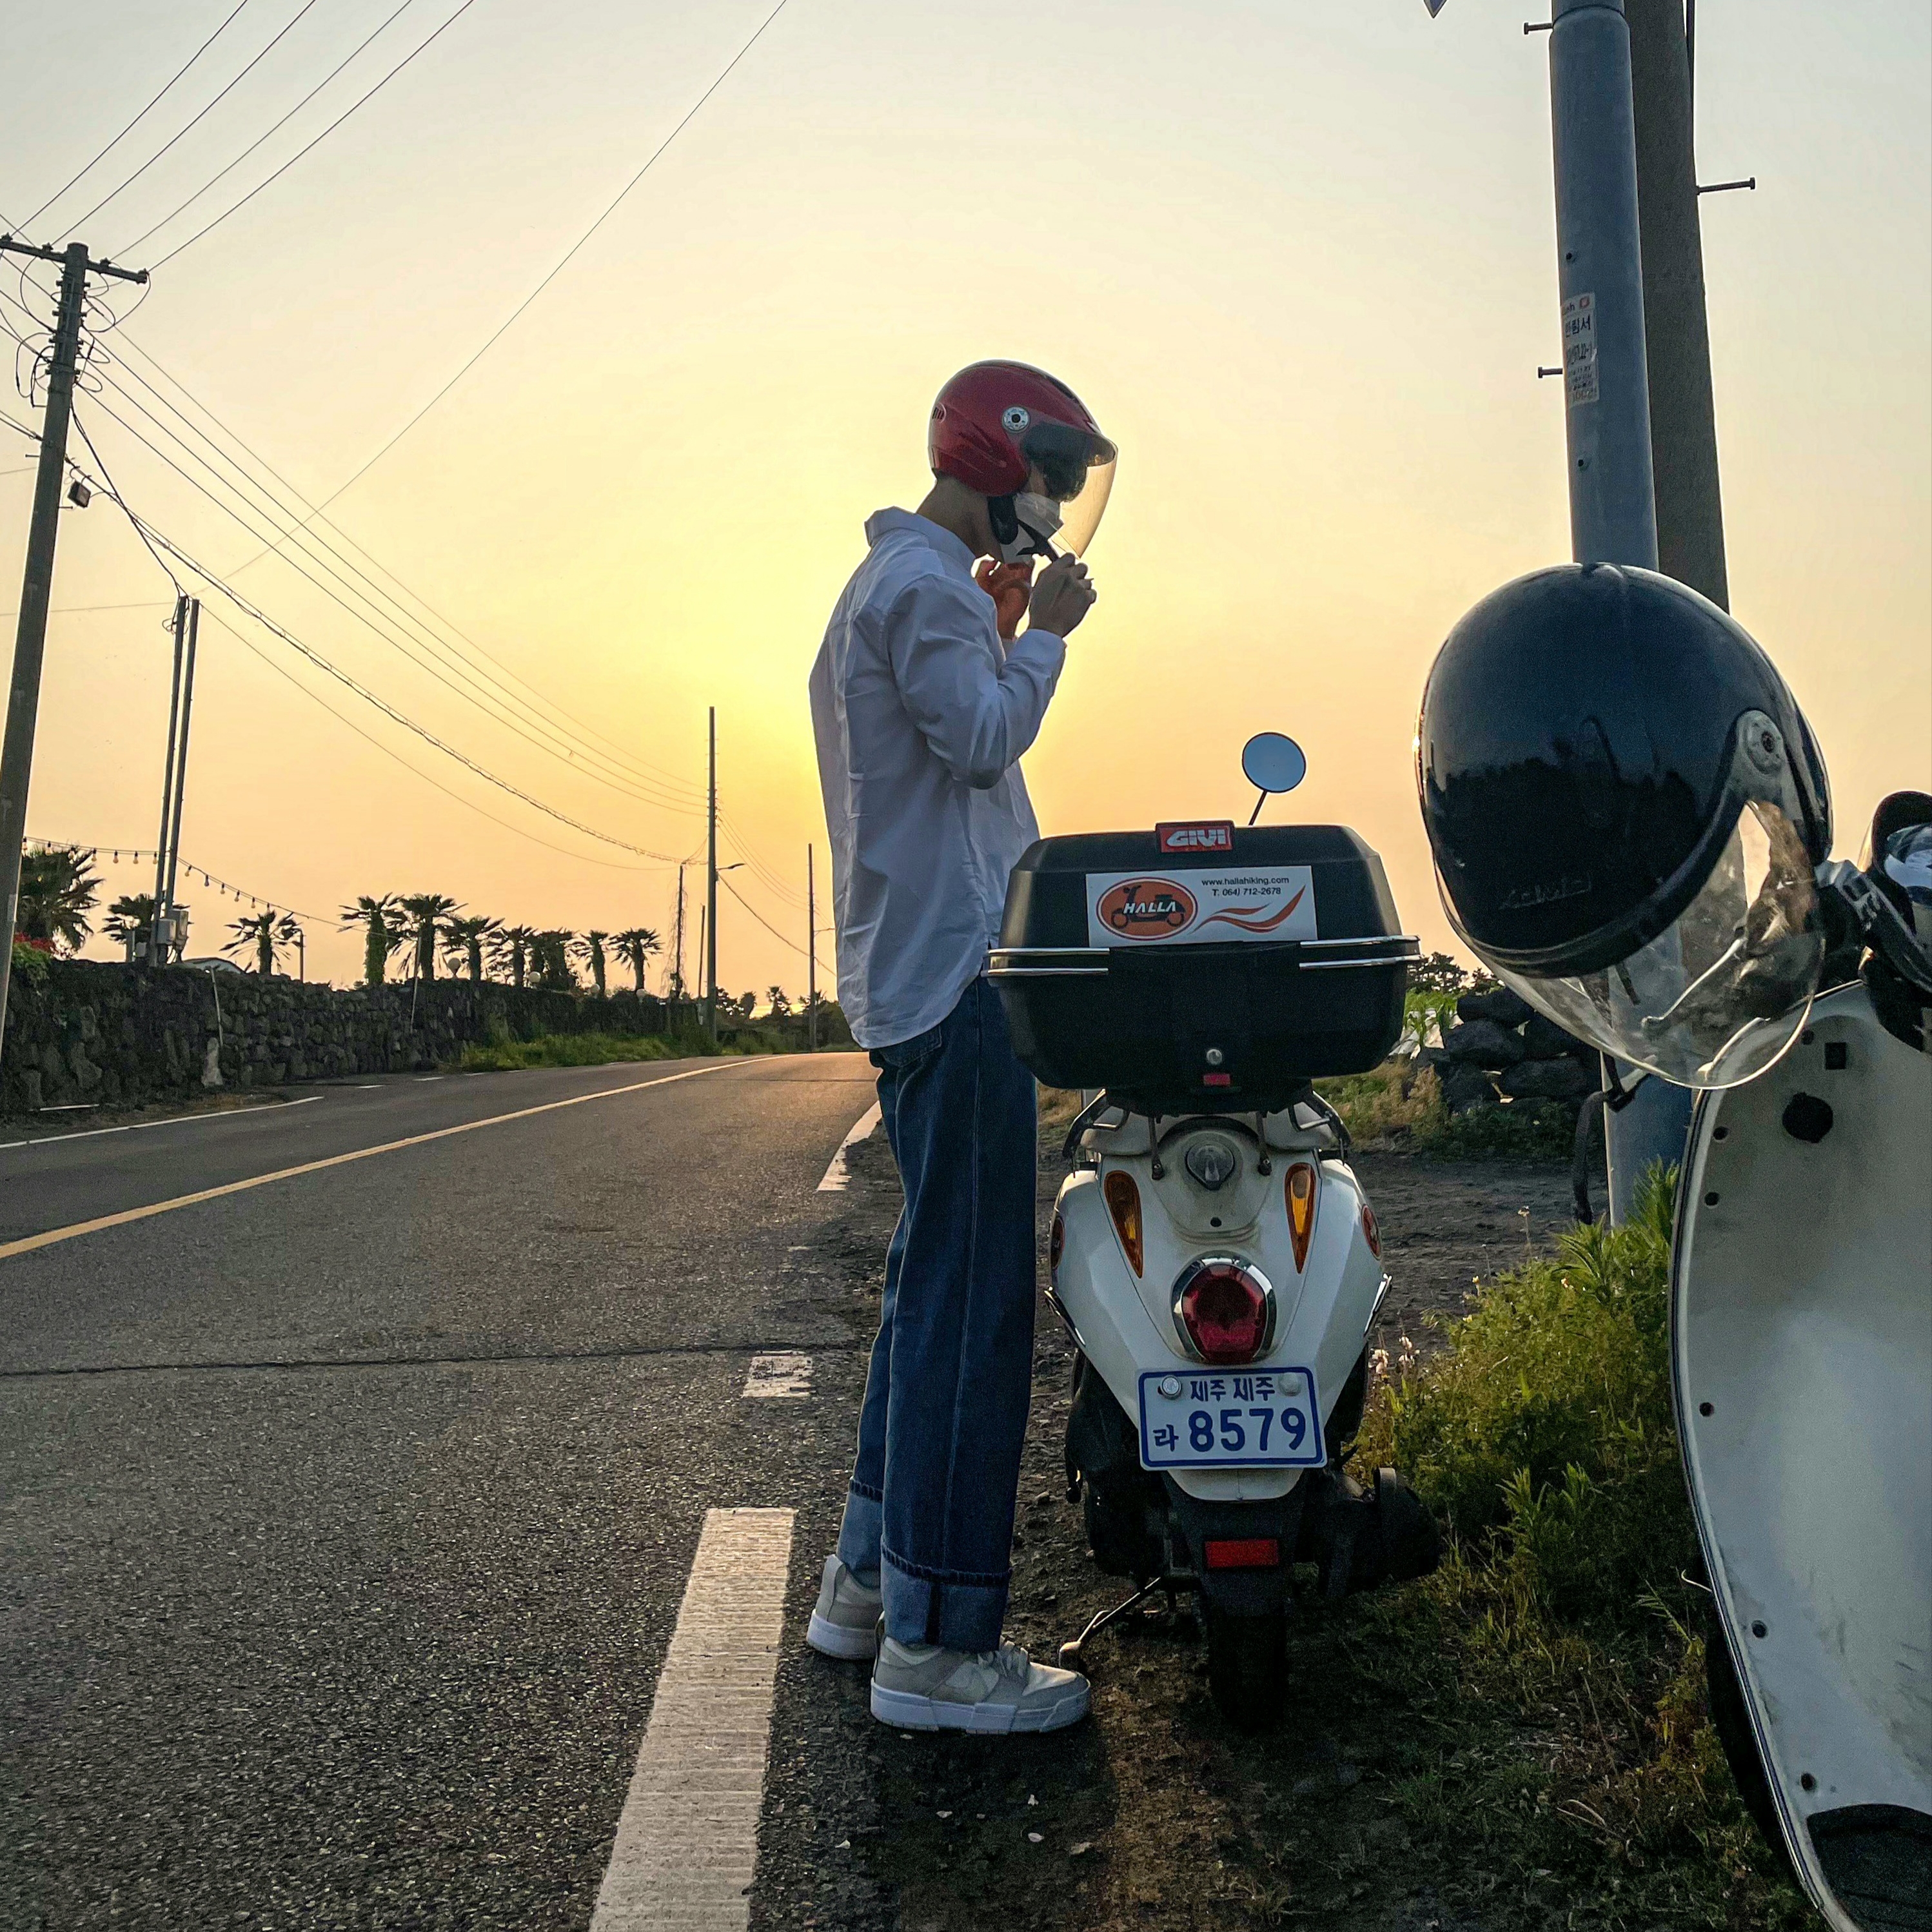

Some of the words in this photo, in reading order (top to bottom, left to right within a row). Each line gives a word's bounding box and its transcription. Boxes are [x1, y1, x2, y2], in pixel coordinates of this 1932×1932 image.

[1167, 829, 1226, 846] GIVI
[1201, 877, 1289, 885] www.hallahiking.com
[1123, 902, 1176, 914] HALLA
[1190, 1379, 1227, 1401] 제주
[1233, 1377, 1275, 1401] 제주
[1153, 1424, 1179, 1452] 라
[1188, 1408, 1306, 1452] 8579
